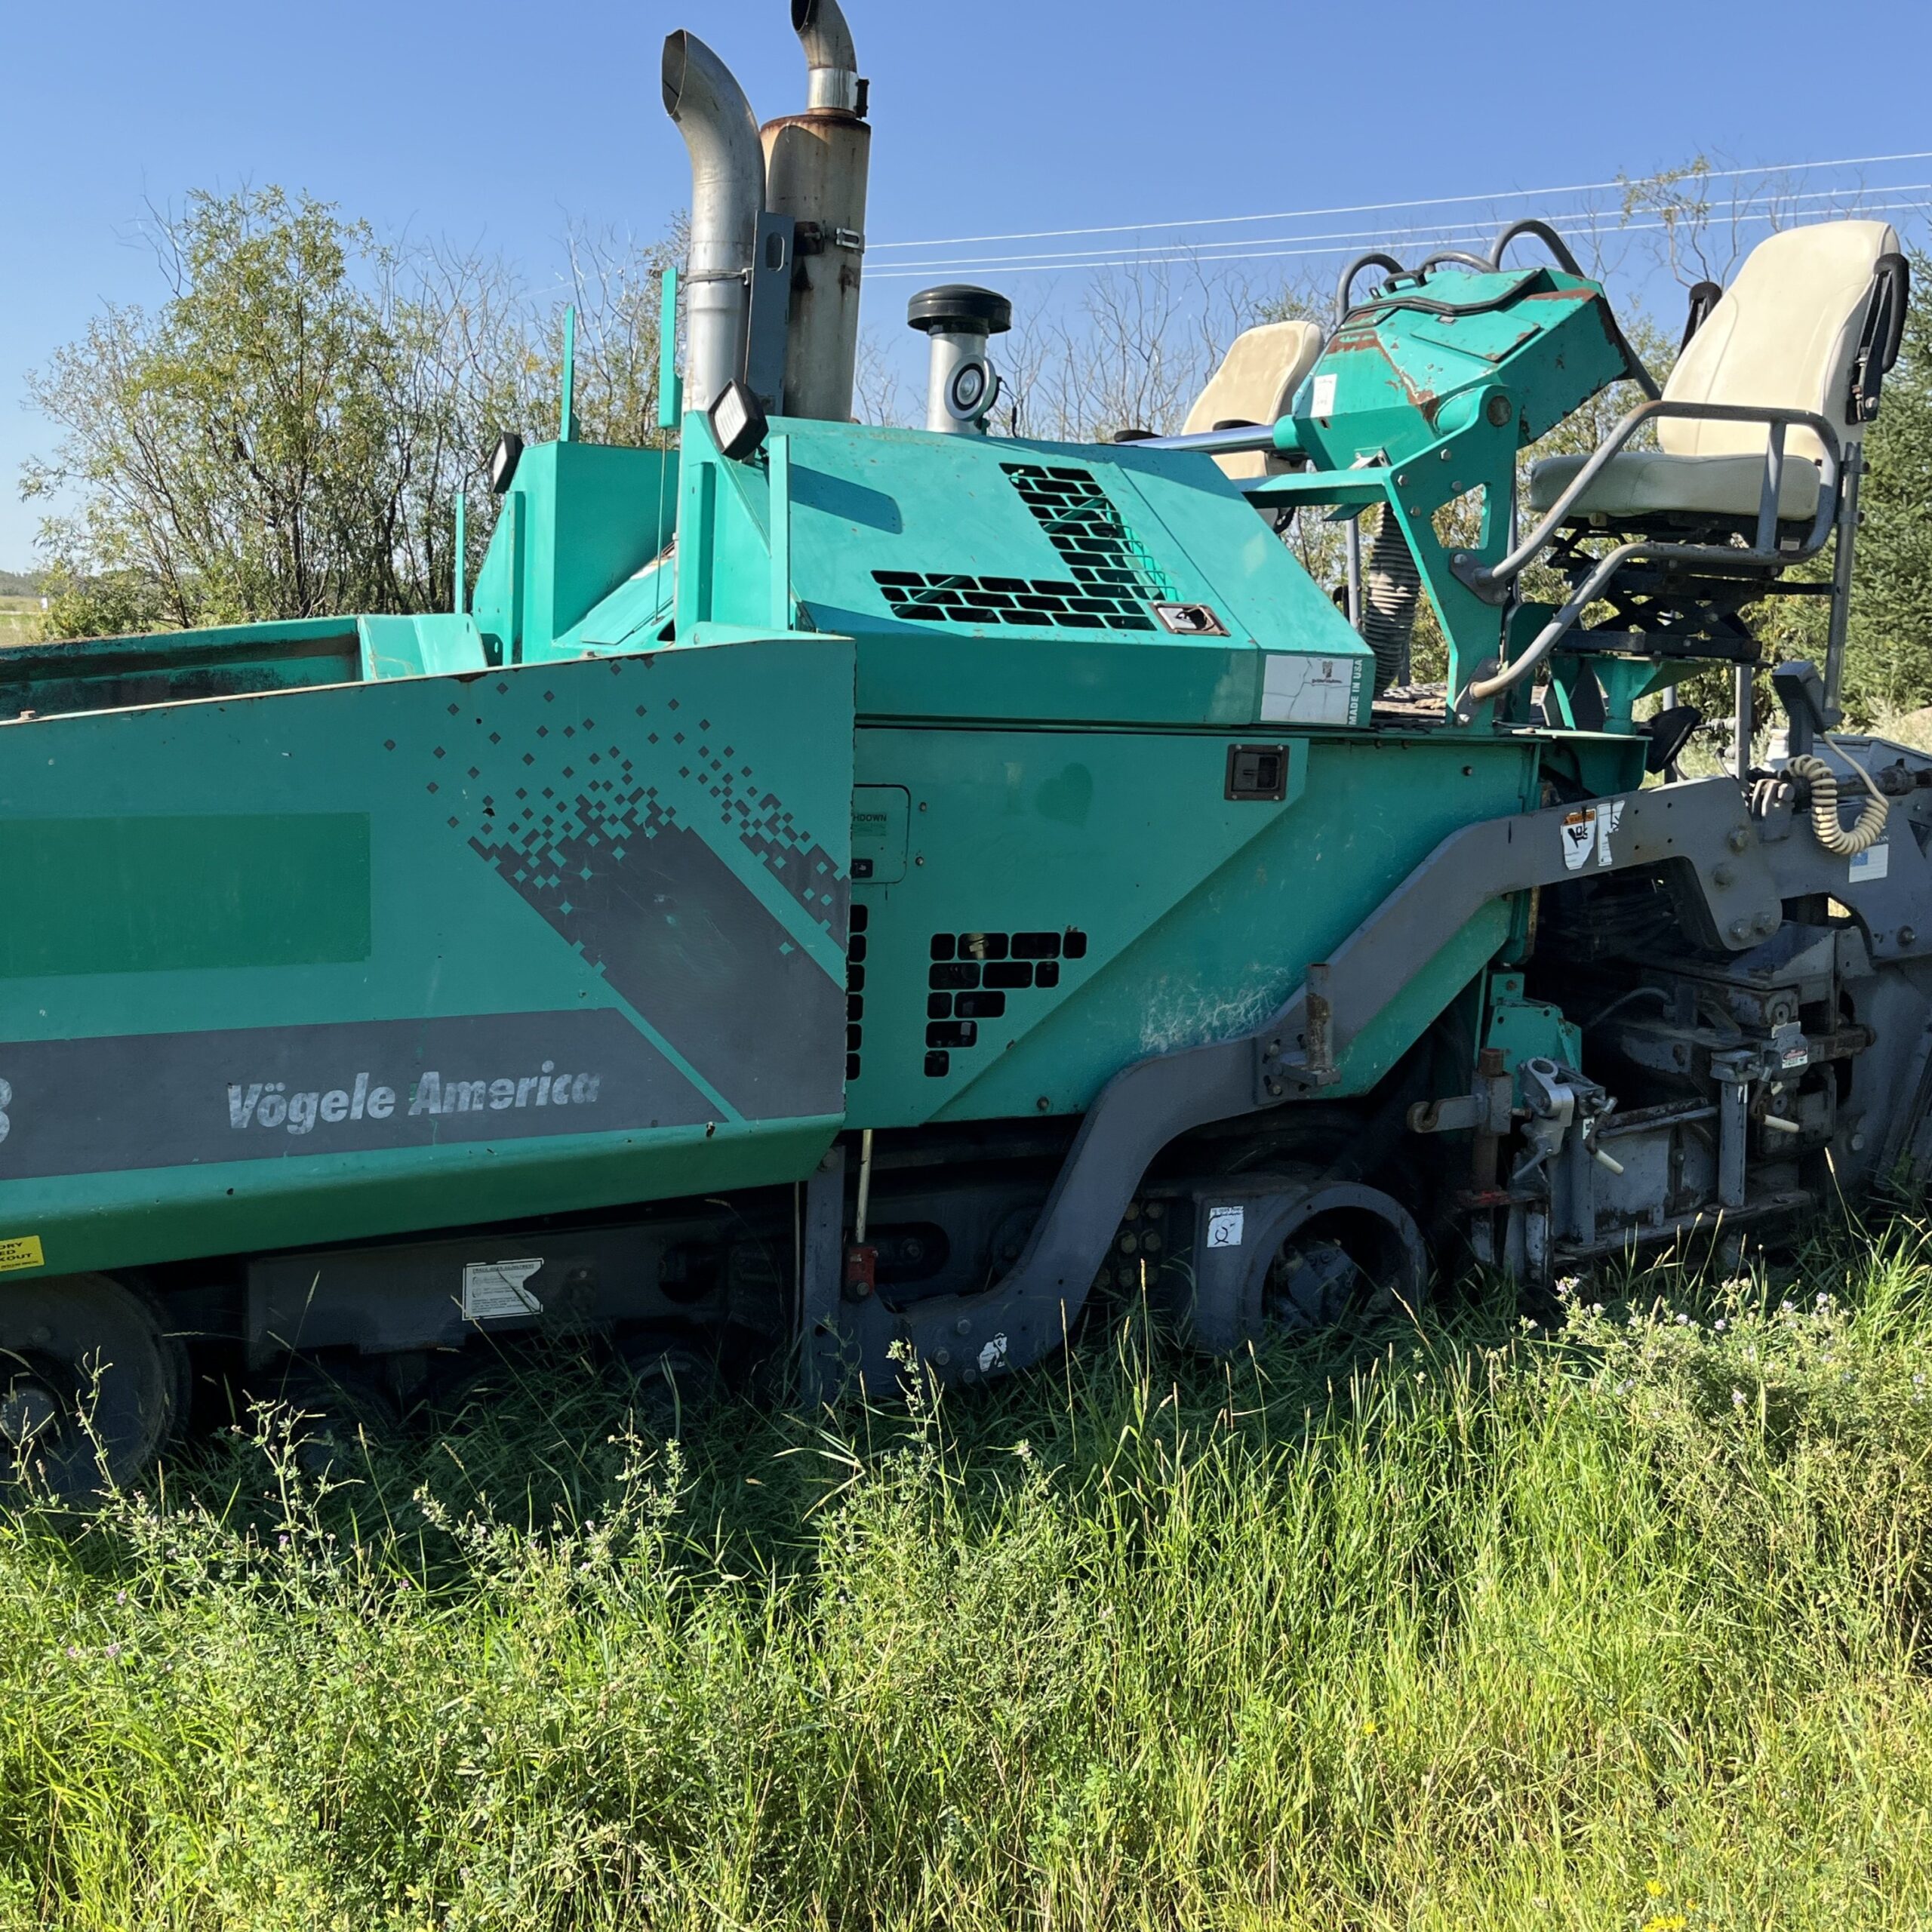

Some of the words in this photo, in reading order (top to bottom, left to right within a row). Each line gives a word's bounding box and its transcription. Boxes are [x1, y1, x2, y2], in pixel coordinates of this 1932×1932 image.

[1353, 660, 1363, 679] USA
[1352, 682, 1360, 693] IN
[1349, 696, 1359, 725] MADE
[228, 1072, 396, 1135] Vögele
[408, 1060, 601, 1116] America
